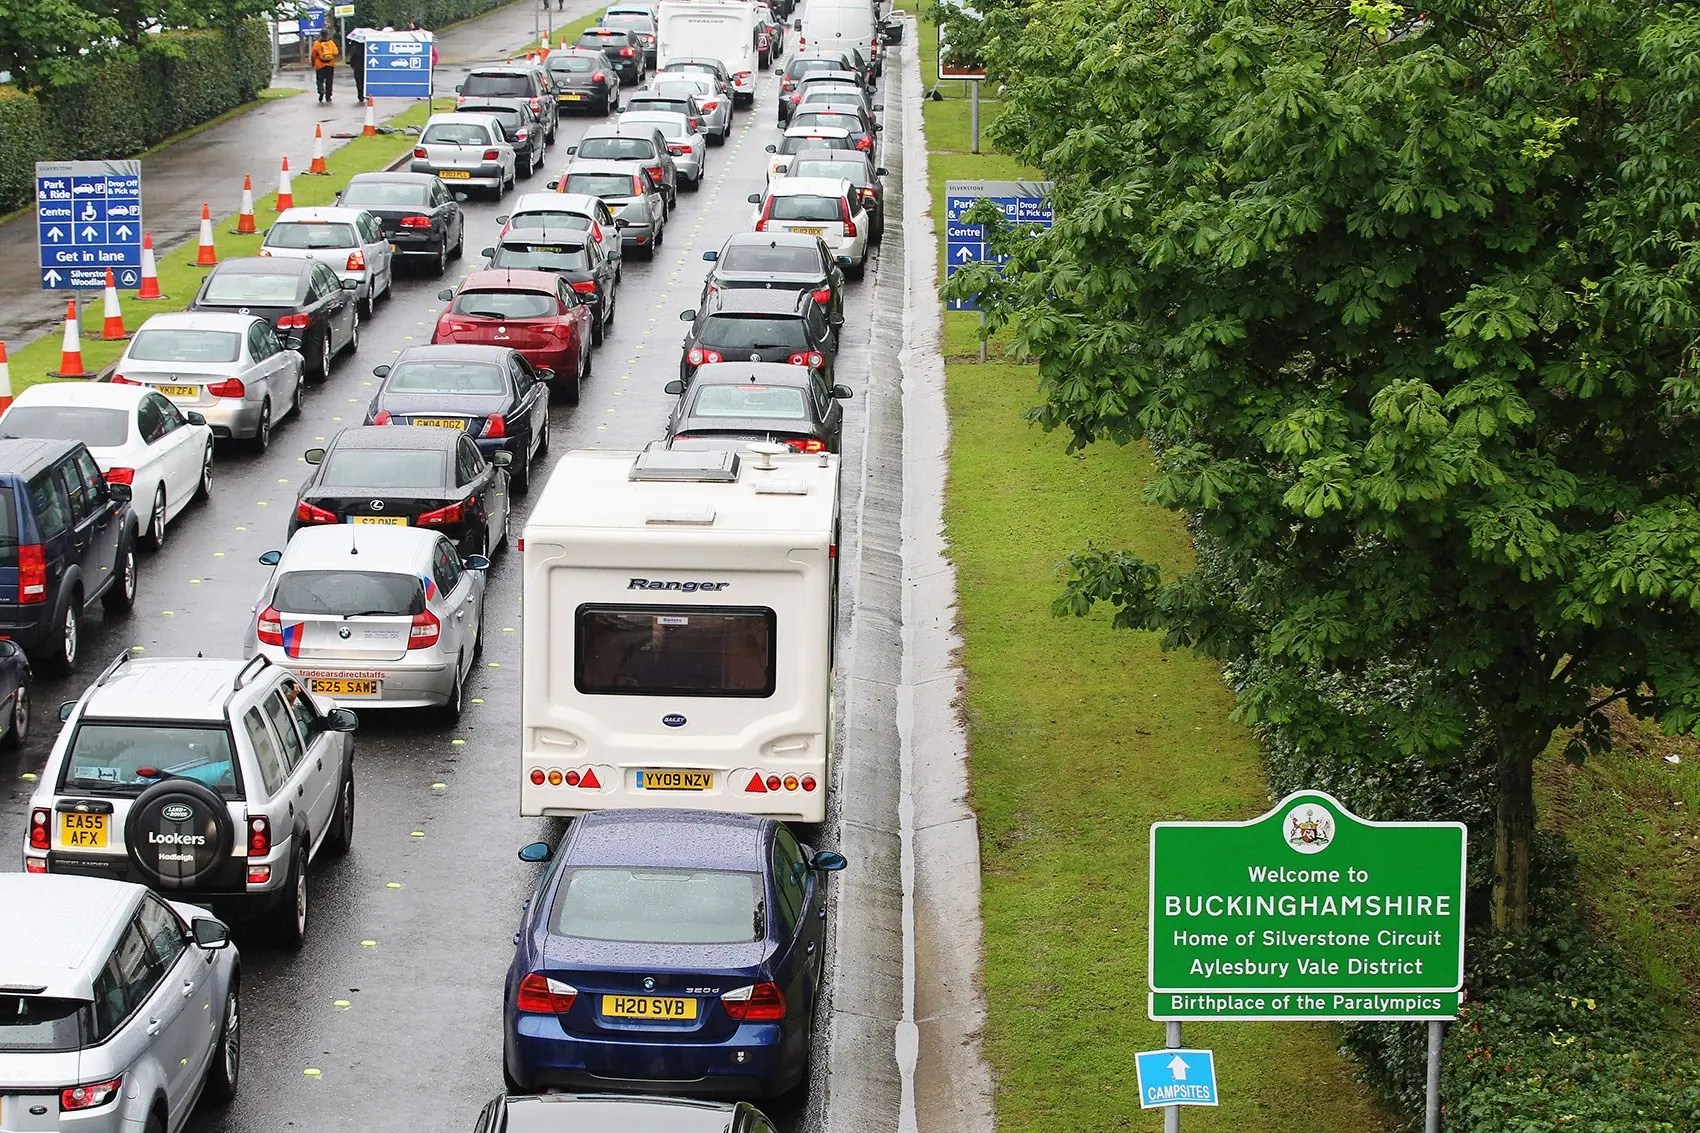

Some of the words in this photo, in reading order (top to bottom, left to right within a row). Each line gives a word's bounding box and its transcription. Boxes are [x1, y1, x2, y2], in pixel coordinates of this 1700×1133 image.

[44, 180, 65, 189] Park
[108, 180, 125, 188] Drop
[126, 179, 138, 187] Off
[39, 190, 47, 199] &
[50, 190, 71, 199] Ride
[130, 188, 139, 196] up
[953, 200, 976, 209] Park
[1019, 202, 1038, 210] Drop
[39, 207, 72, 217] Centre
[948, 211, 956, 219] &
[1026, 209, 1041, 217] Pick
[1042, 209, 1052, 218] up
[948, 227, 981, 237] Centre
[56, 251, 79, 262] Get
[82, 250, 94, 262] in
[99, 250, 125, 261] lane
[70, 270, 114, 278] Silversto
[70, 278, 107, 286] Woodlan
[176, 386, 193, 395] ZFA
[626, 578, 730, 593] Ranger
[318, 681, 341, 692] S25
[646, 773, 681, 786] YY09
[684, 774, 711, 787] NZV
[66, 814, 103, 829] EA55
[71, 831, 98, 845] AFX
[148, 831, 206, 846] Lookers
[158, 853, 194, 862] Hadleigh
[1247, 866, 1340, 883] Welcome
[1347, 866, 1369, 883] to
[1165, 895, 1451, 917] BUCKINGHAMSHIRE
[1173, 930, 1229, 946] Home
[1235, 930, 1255, 946] of
[1262, 930, 1370, 946] Silverstone
[1377, 930, 1442, 946] Circuit
[1189, 958, 1290, 979] Aylesbury
[1296, 958, 1339, 975] Vale
[1348, 958, 1423, 975] District
[614, 998, 648, 1014] H20
[652, 1000, 685, 1015] SVB
[1171, 995, 1266, 1013] Birthplace
[1271, 995, 1291, 1010] of
[1296, 995, 1326, 1010] the
[1333, 994, 1441, 1012] Paralympics
[1148, 1085, 1210, 1100] CAMPSITES
